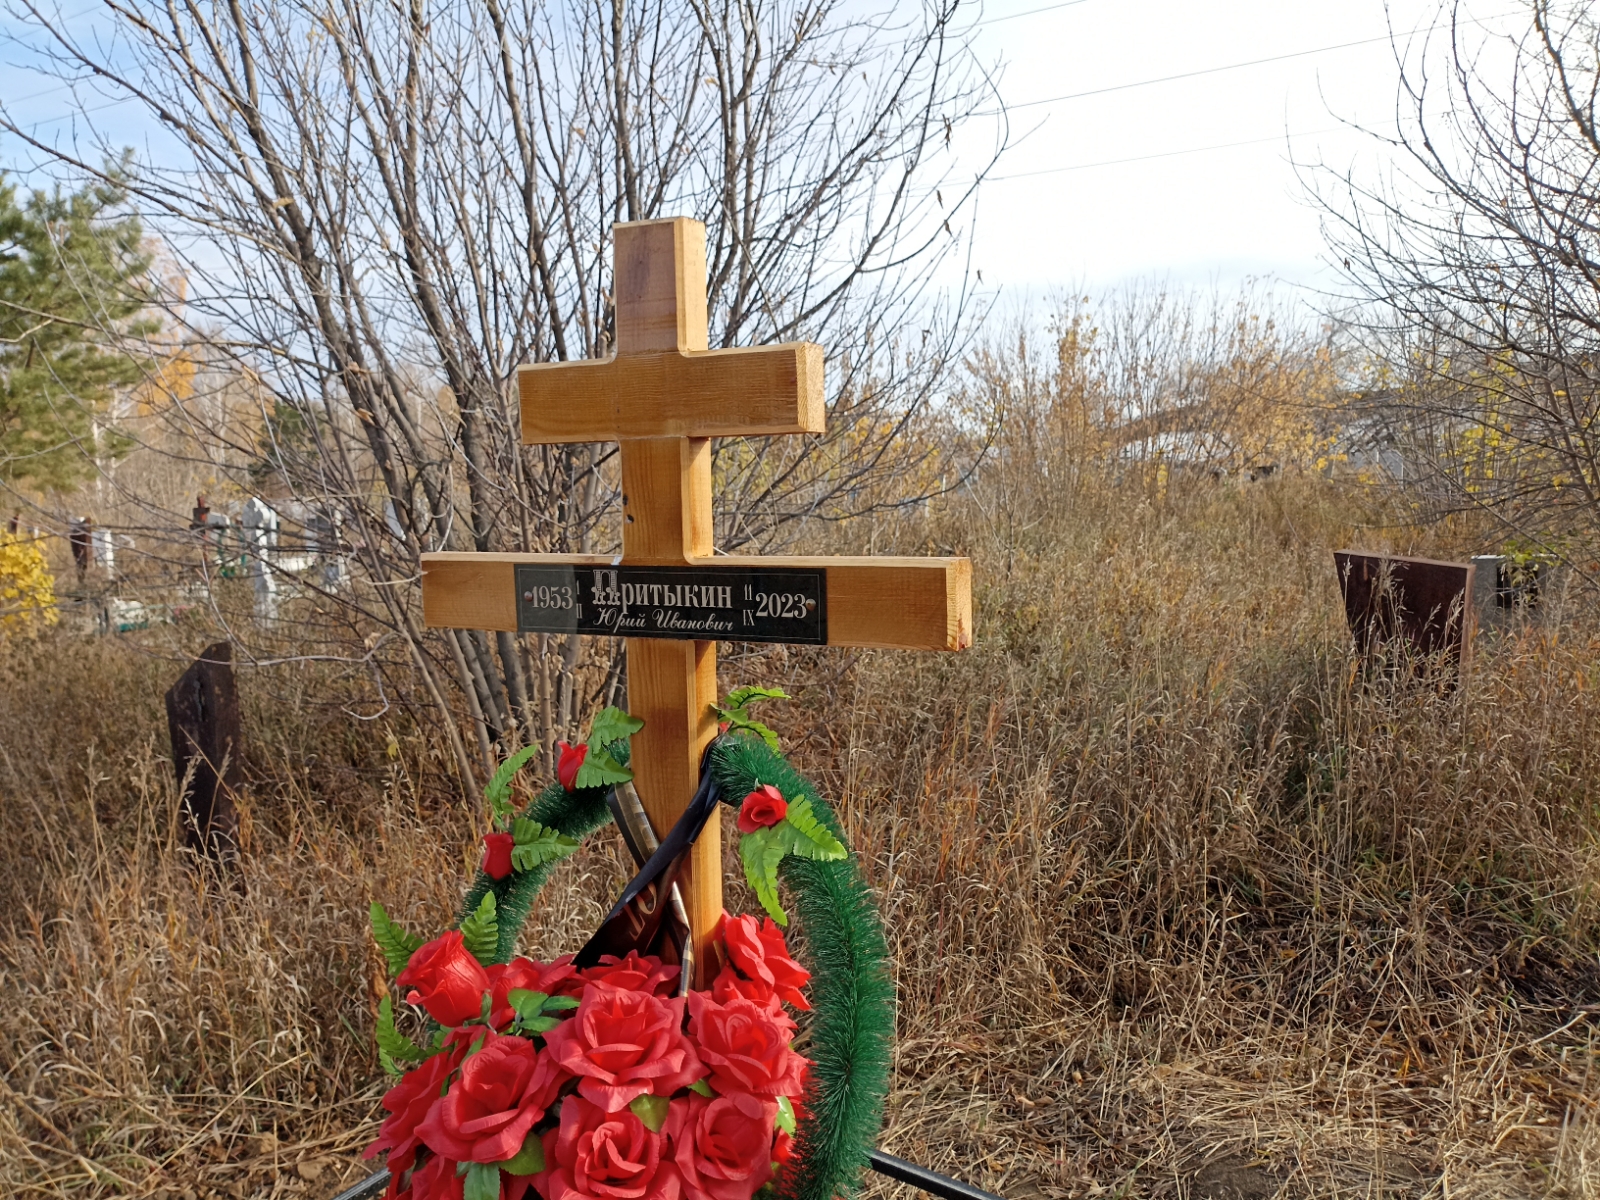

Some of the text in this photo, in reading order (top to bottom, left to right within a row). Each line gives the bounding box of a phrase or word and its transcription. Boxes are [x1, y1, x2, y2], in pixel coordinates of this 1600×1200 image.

[531, 585, 573, 610] 1953
[591, 569, 733, 614] Притыкин
[742, 609, 755, 626] IX
[755, 592, 807, 618] 2023
[593, 607, 734, 633] Юрий Иванович
